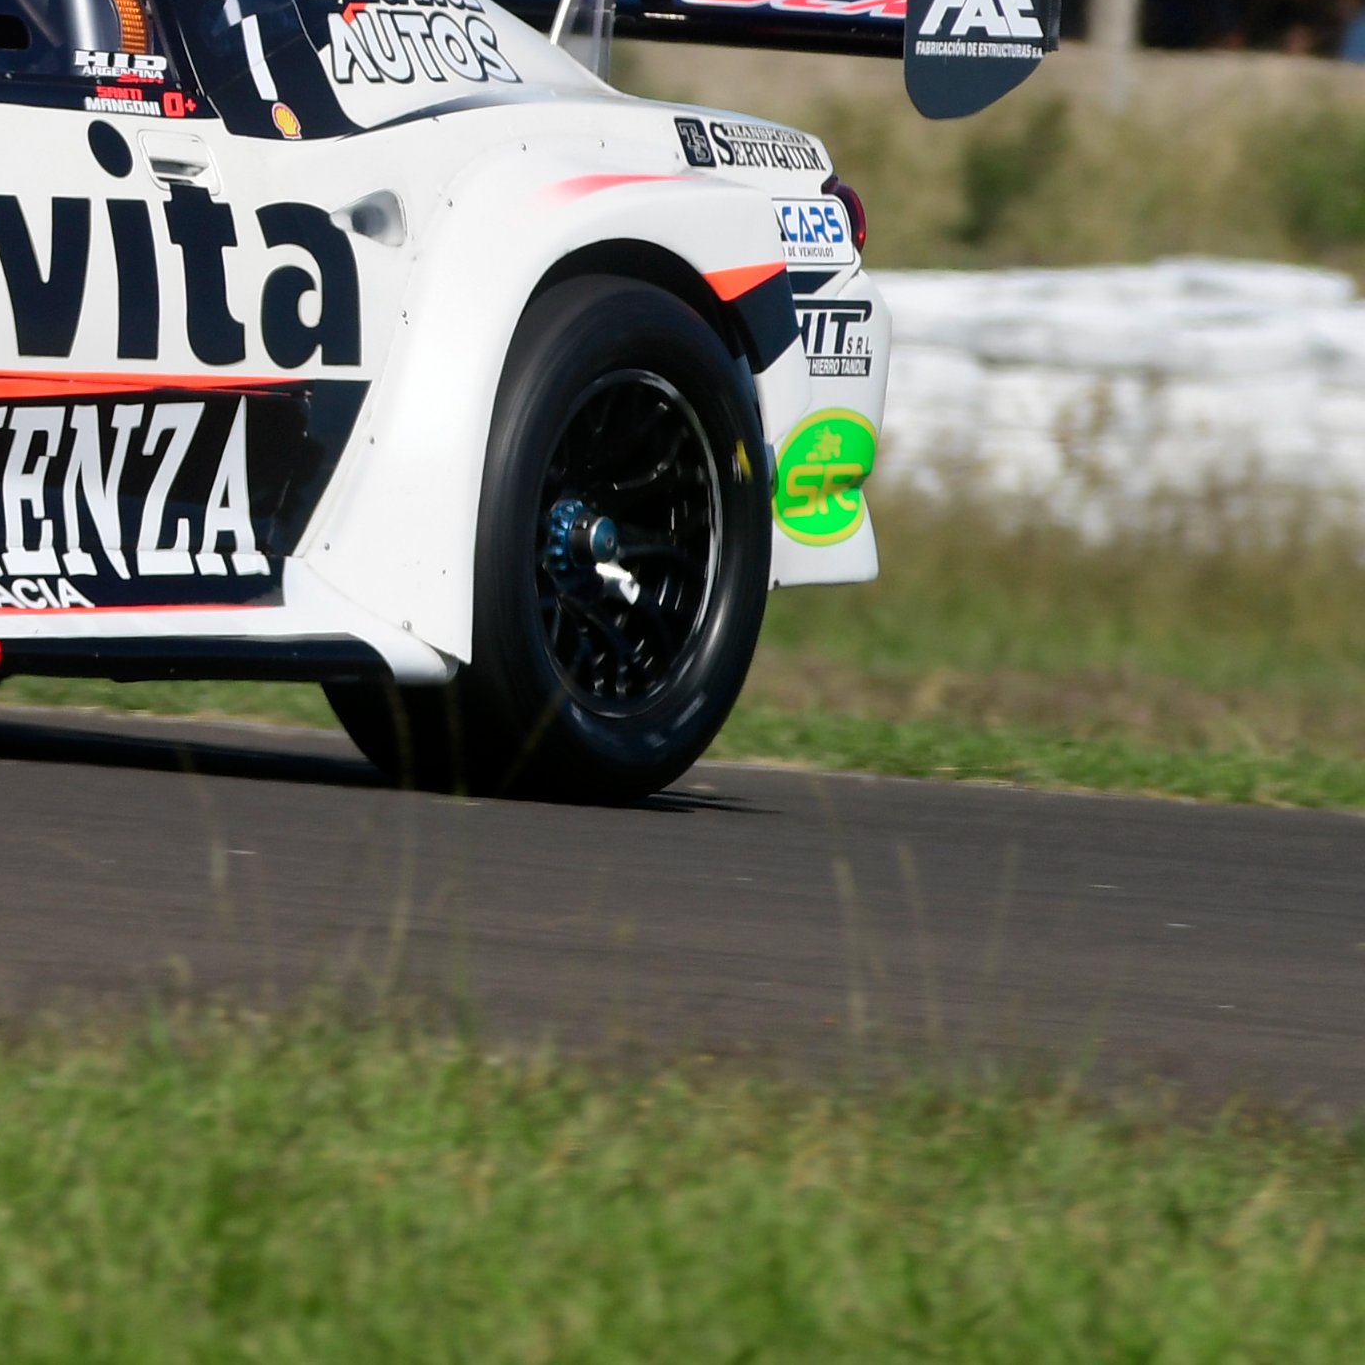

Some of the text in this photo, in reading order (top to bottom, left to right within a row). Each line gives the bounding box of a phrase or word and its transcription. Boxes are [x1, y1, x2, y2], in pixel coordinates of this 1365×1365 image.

[326, 9, 523, 84] AUTOS
[967, 42, 977, 57] DE
[74, 50, 167, 71] HID
[81, 66, 164, 80] ARGENTINA
[95, 86, 143, 100] SANTI
[85, 96, 161, 117] MANGONI
[709, 121, 827, 171] SERVIQUIM
